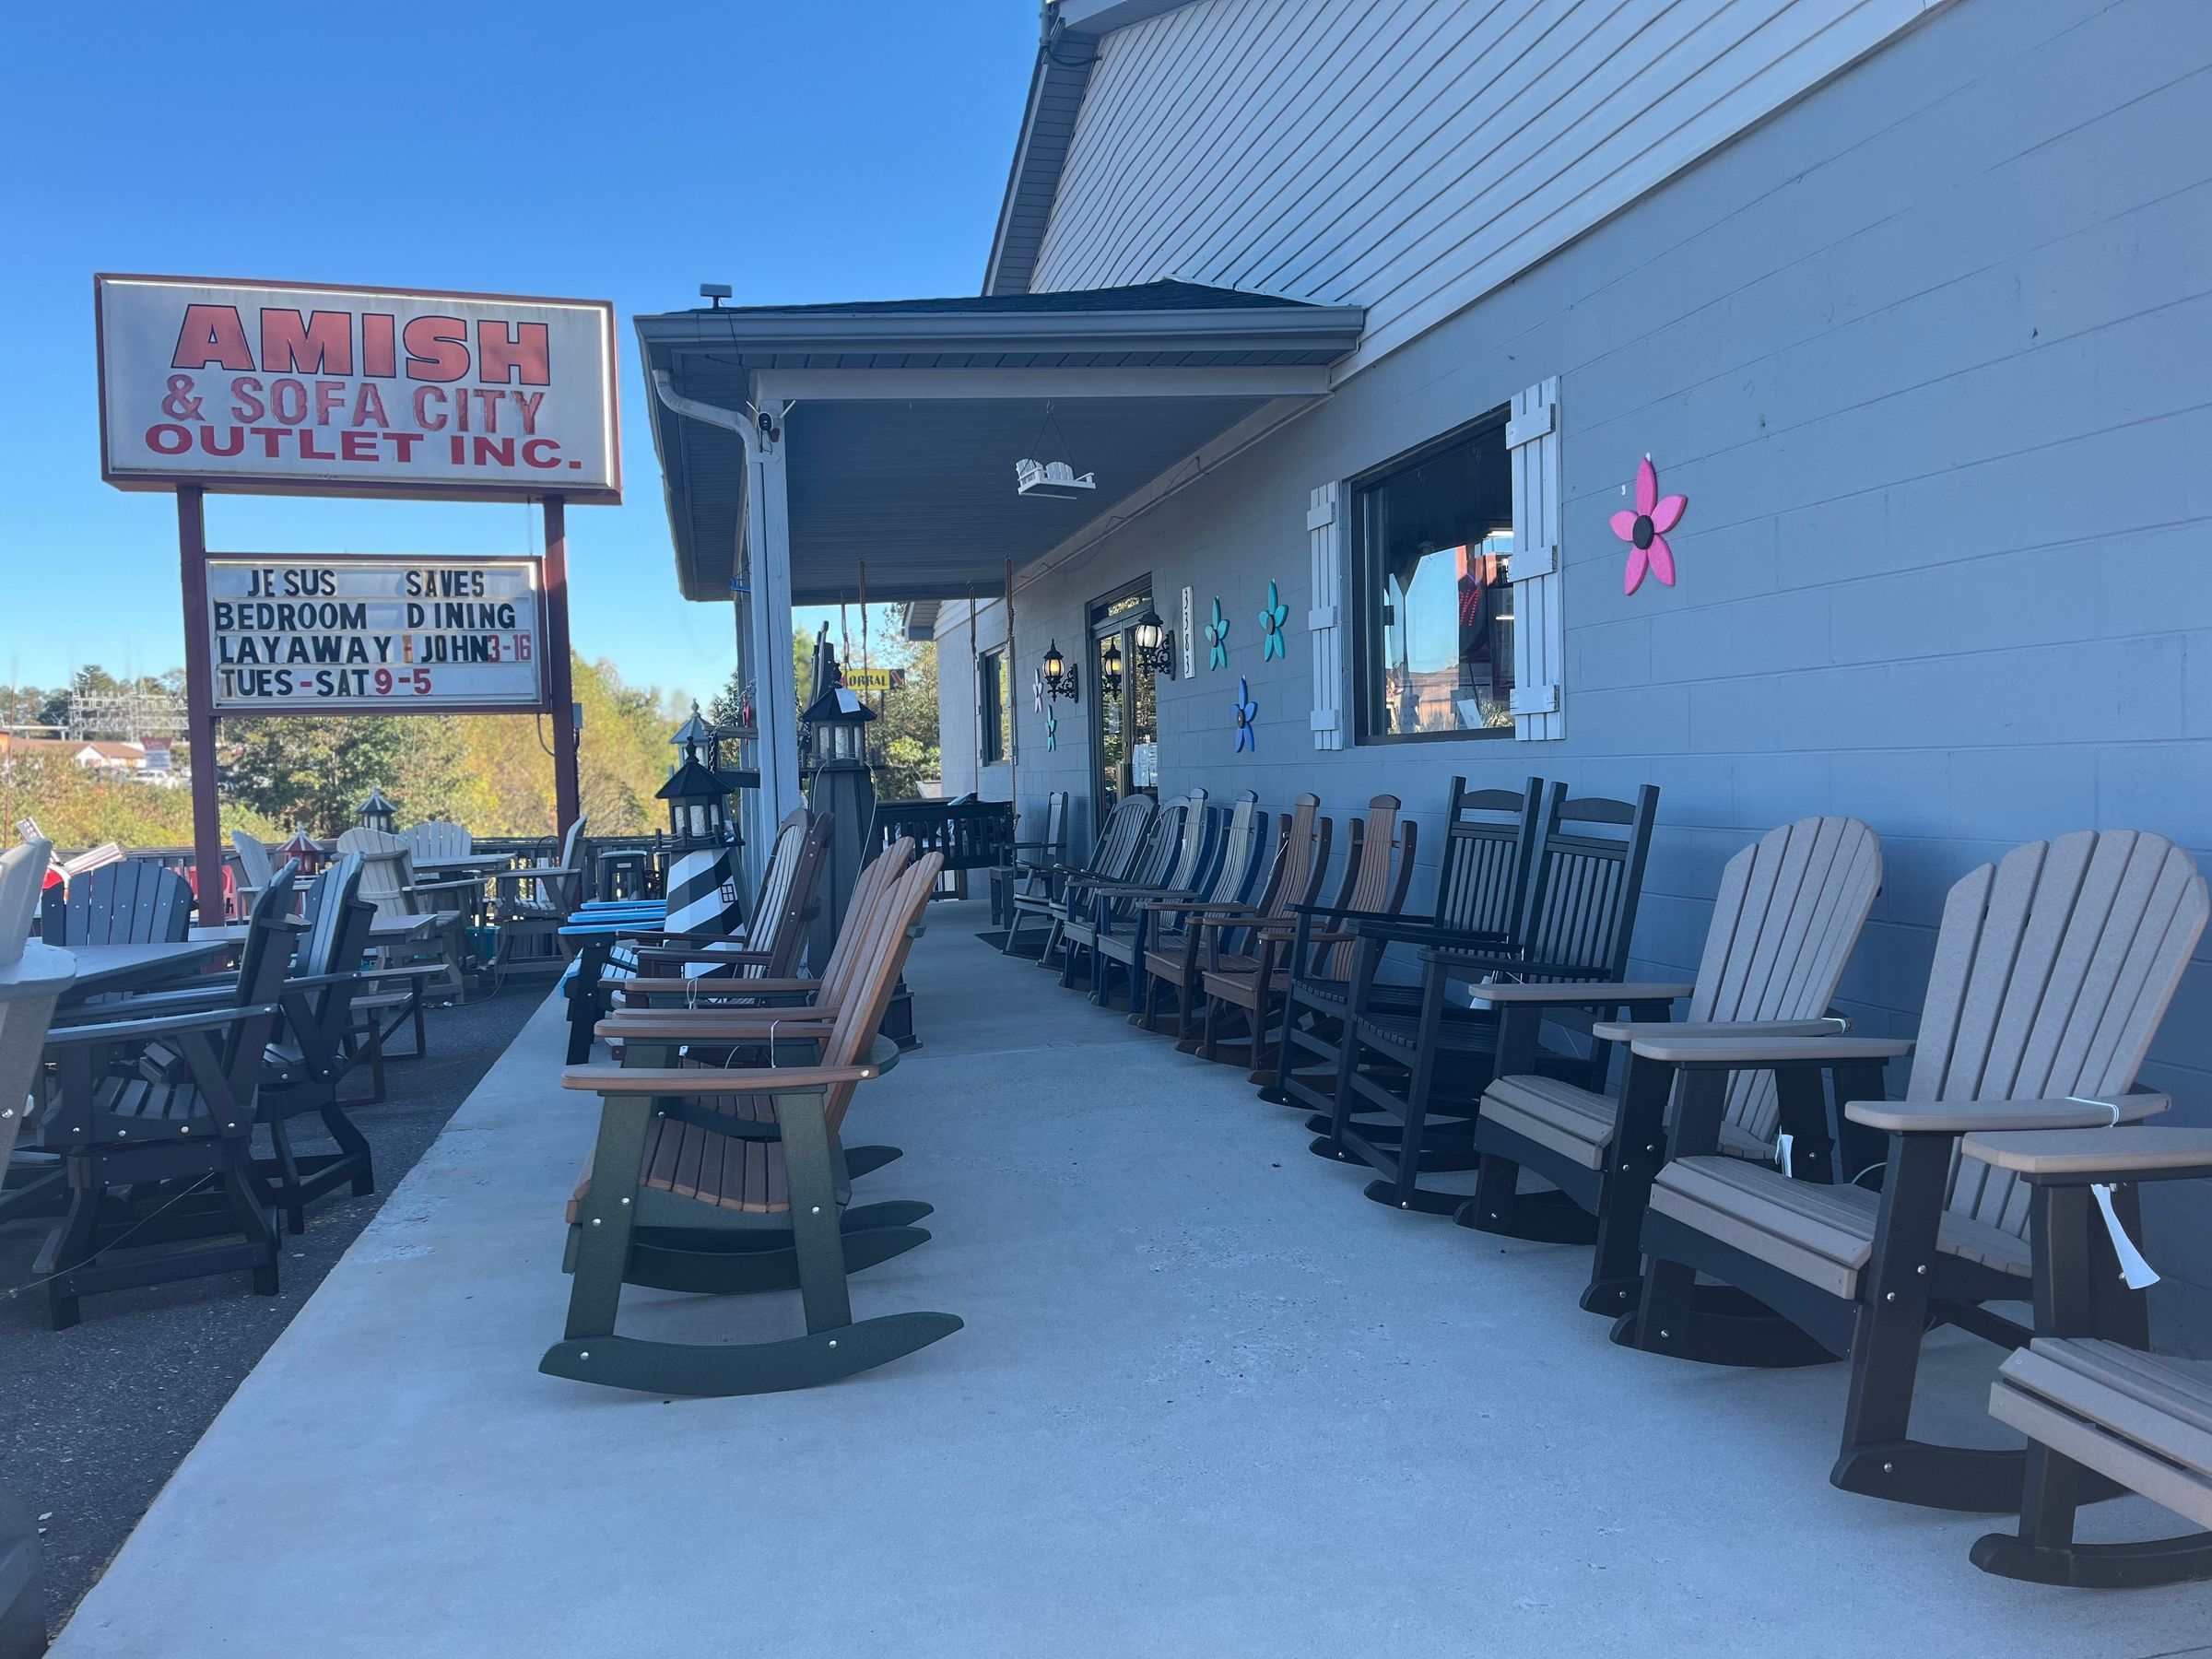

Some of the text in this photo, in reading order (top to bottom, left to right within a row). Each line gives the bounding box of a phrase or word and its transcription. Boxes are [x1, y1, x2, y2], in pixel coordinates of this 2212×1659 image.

[171, 303, 551, 386] AMISH
[160, 373, 546, 435] & SOFA CITY
[145, 423, 582, 469] OUTLET INC.
[247, 569, 485, 597] JESUS SAVES
[215, 602, 516, 630] BEDROOM DINING
[218, 635, 392, 664] LAYAWAY
